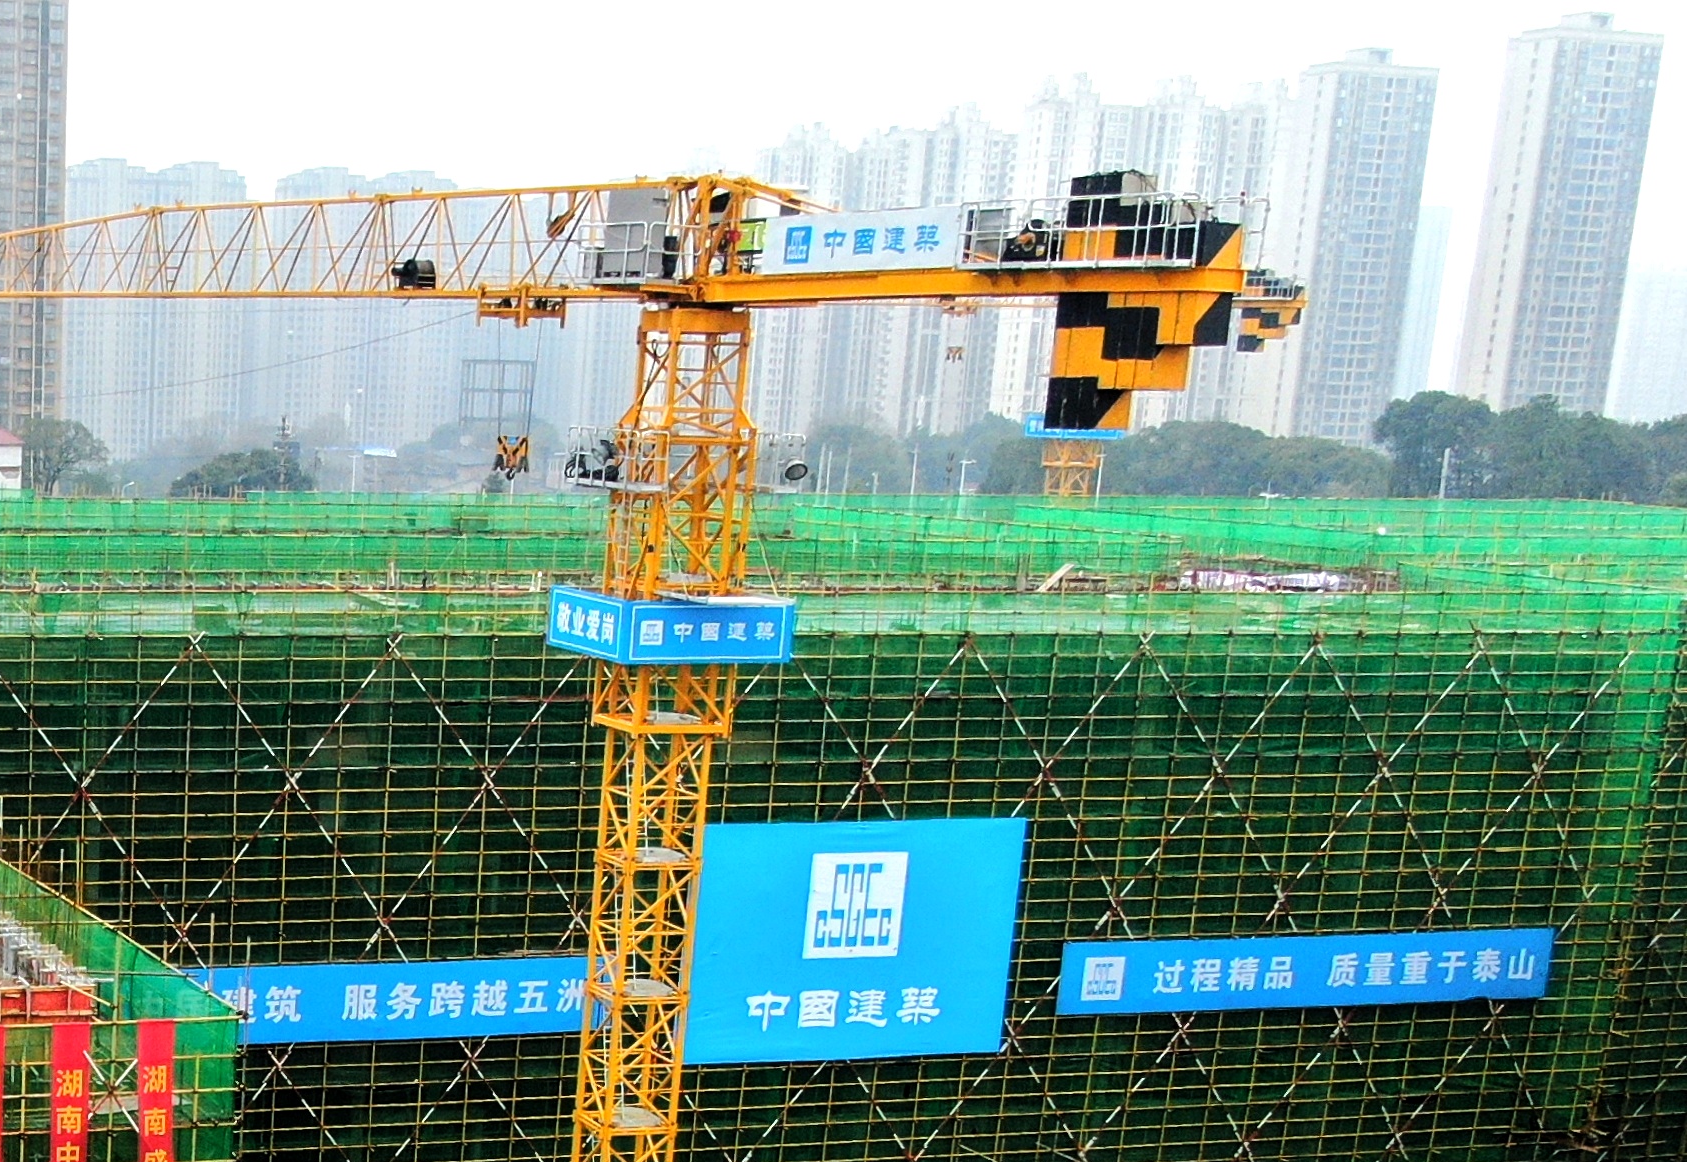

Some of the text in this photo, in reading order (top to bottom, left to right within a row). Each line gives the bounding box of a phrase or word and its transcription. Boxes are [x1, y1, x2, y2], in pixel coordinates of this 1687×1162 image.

[557, 601, 614, 646] 敬业爱岗
[1153, 956, 1294, 994] 过程精品
[1326, 948, 1534, 988] 质量重于泰山
[342, 978, 588, 1021] 服务跨越五洲
